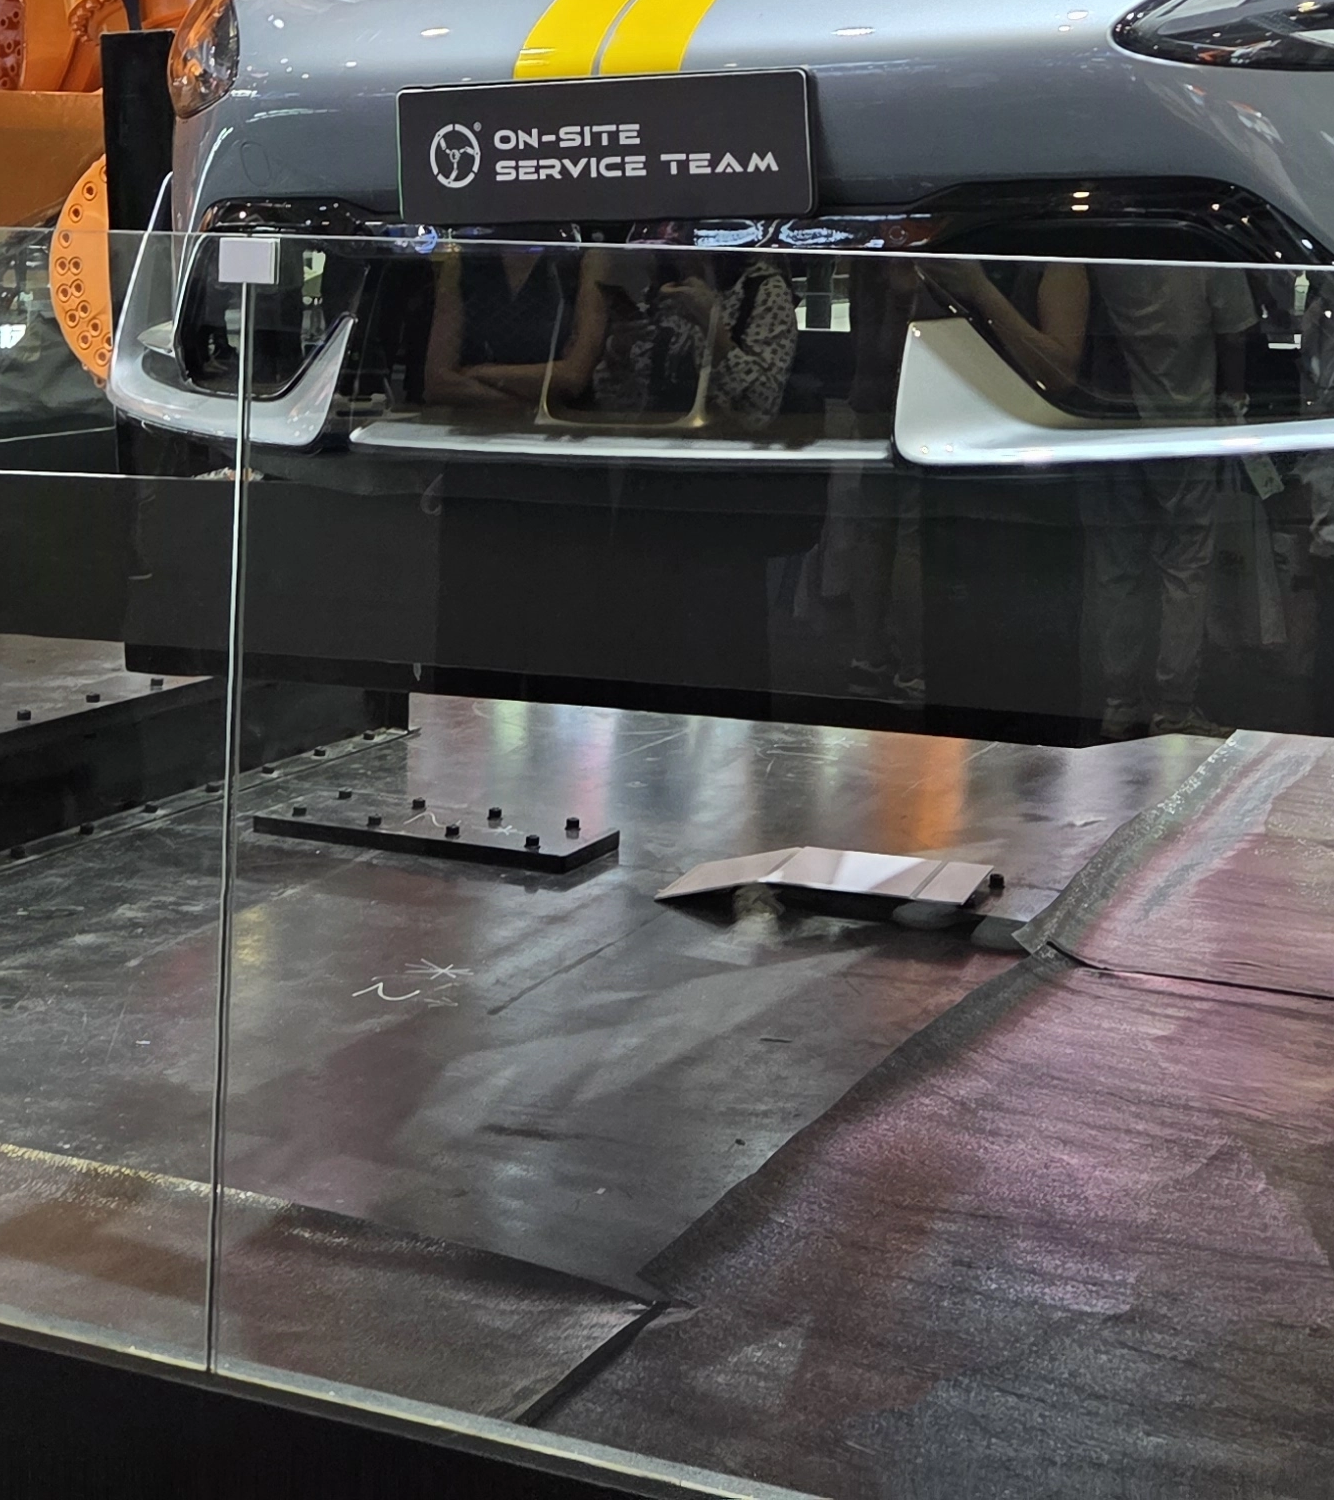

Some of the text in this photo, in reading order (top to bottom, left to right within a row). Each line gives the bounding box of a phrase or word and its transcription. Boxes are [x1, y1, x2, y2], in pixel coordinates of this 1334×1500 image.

[494, 123, 641, 151] ON-SITE
[495, 151, 779, 182] SERVICE TEAM
